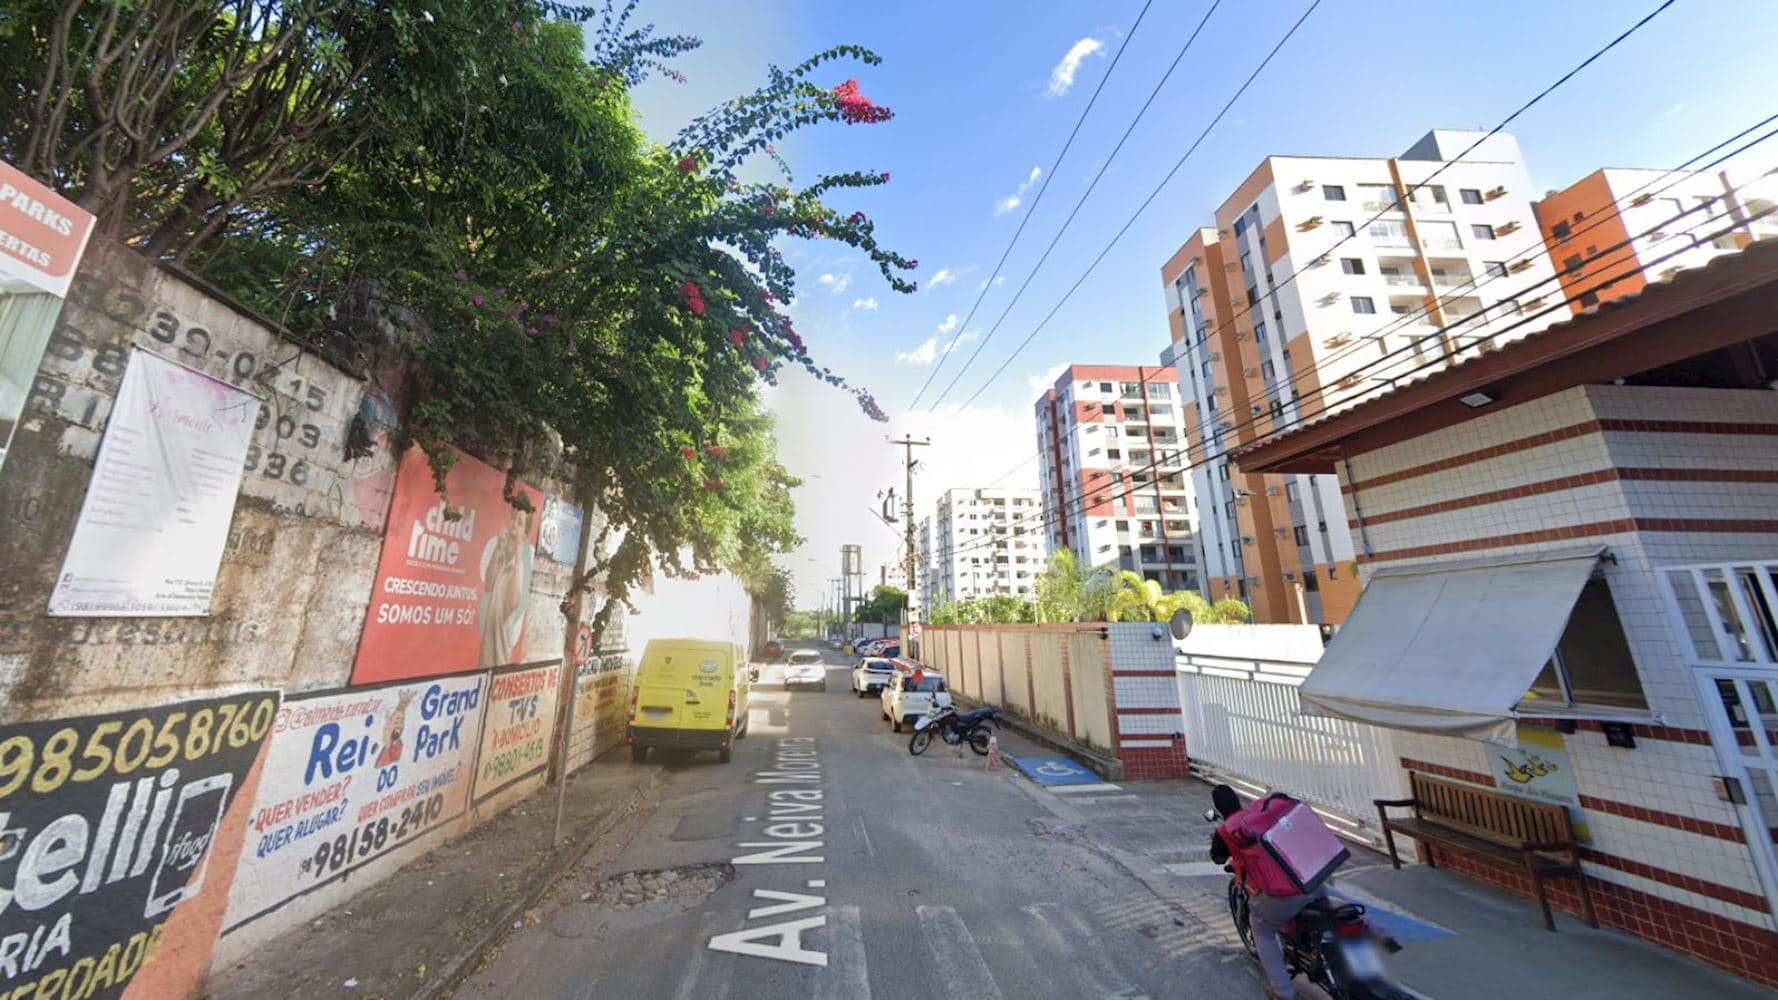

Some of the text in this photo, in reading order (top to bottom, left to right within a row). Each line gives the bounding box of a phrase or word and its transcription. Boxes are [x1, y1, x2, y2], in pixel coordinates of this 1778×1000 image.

[0, 183, 74, 237] PARKS
[377, 603, 433, 625] SOMOS
[434, 607, 454, 624] UM
[384, 576, 446, 598] CRESCENDO
[421, 677, 482, 721] Grand
[0, 698, 275, 799] 985058760
[304, 714, 374, 786] Rei
[255, 774, 352, 832] QUER VENDER?
[376, 765, 398, 792] DO
[257, 798, 348, 859] QUER ALUGAR?
